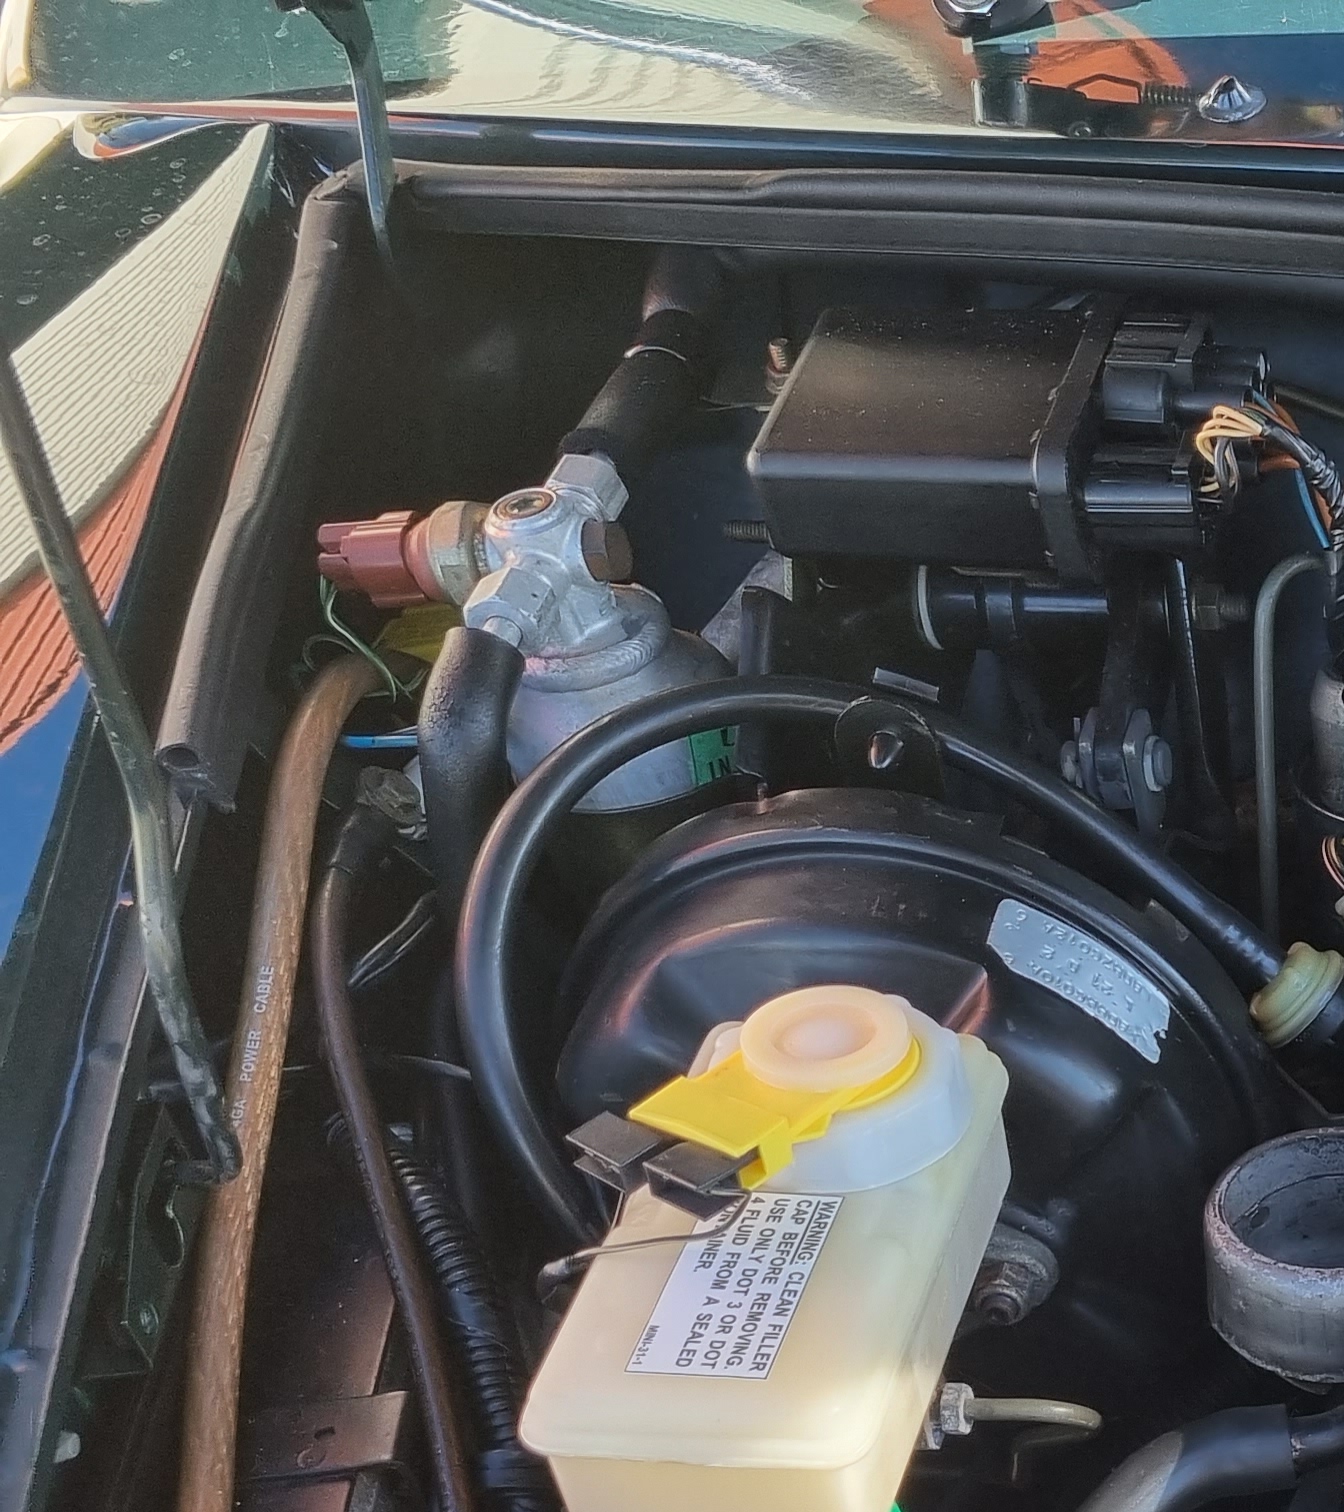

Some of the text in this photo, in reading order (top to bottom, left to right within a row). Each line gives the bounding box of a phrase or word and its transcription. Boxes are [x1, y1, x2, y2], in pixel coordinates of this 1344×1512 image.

[240, 1030, 262, 1082] POWER
[253, 965, 275, 1014] CABLE
[631, 1325, 660, 1366] MINI-31-1
[675, 1196, 765, 1368] 4 FLUID FROM A SEALED
[701, 1198, 791, 1369] USE ONLY DOT 3 OR DOT
[723, 1199, 812, 1370] CAP BEFORE REMOVING.
[749, 1200, 838, 1372] WARNING: CLEAN FILLER
